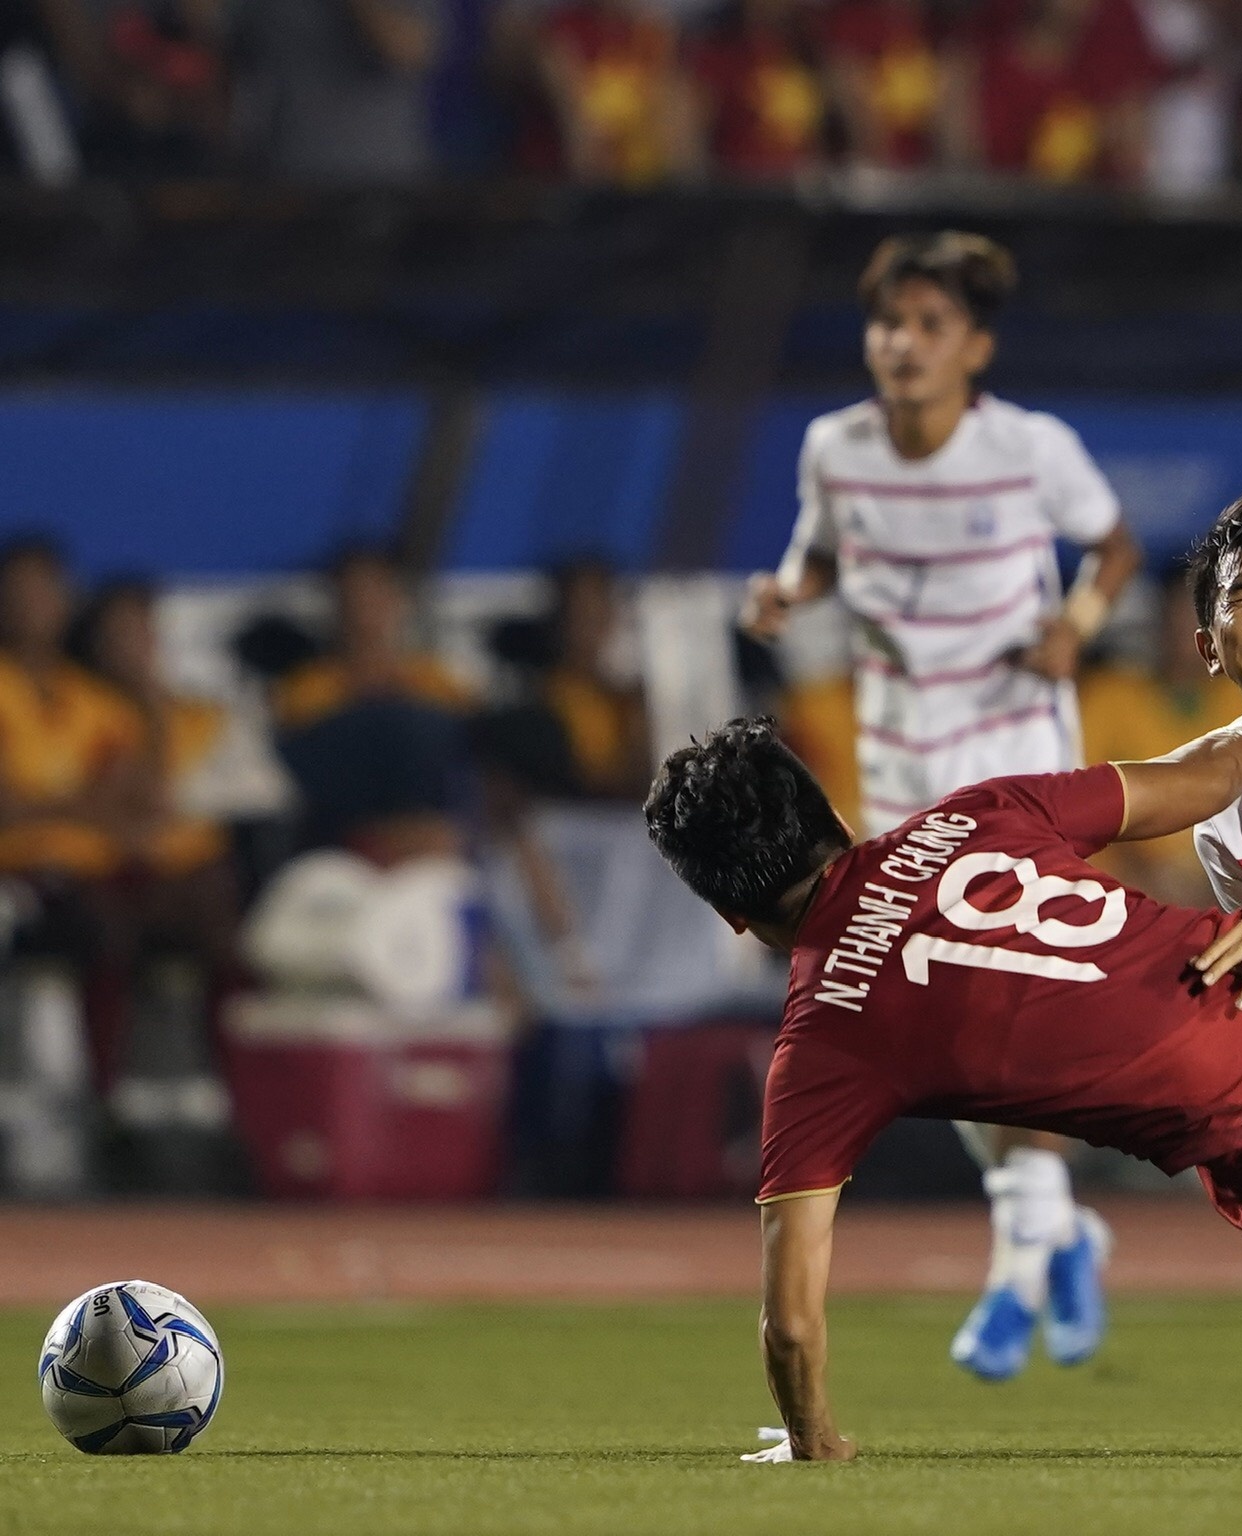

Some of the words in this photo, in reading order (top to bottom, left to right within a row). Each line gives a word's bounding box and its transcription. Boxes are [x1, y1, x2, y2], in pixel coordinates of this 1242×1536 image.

[814, 881, 919, 1013] N.THANH
[879, 811, 978, 883] CHUNG
[901, 852, 1128, 987] 18
